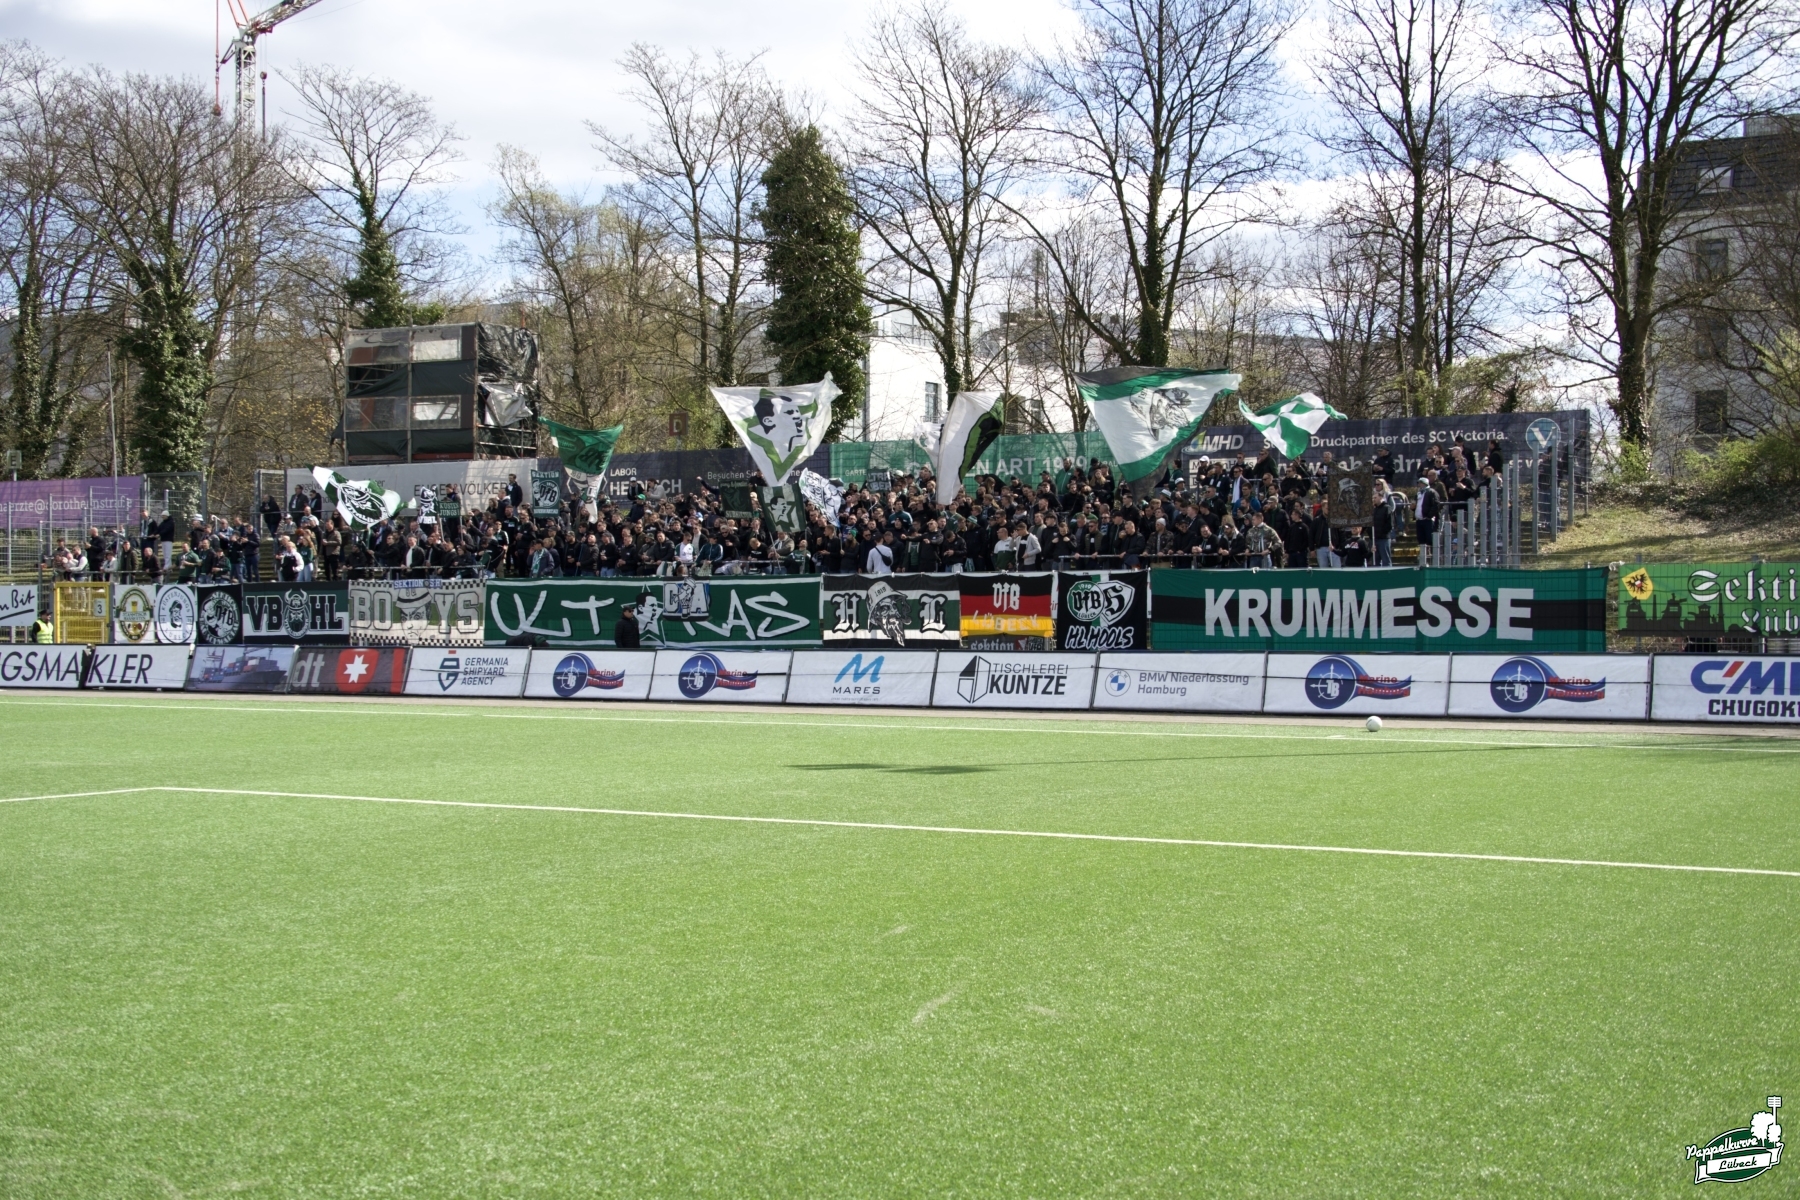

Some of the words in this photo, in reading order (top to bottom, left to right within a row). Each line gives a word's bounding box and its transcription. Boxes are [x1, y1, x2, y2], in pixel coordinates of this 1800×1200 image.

[673, 418, 682, 433] D
[1202, 434, 1244, 450] MHD
[1311, 432, 1397, 450] Druckpartner
[1401, 432, 1425, 444] des
[1428, 431, 1447, 443] SC
[1449, 428, 1508, 442] Victoria.
[11, 456, 17, 467] E
[995, 457, 1036, 476] ART
[609, 467, 637, 477] LABOR
[707, 471, 744, 480] Besuchen
[394, 579, 423, 588] SEKTION
[11, 588, 35, 609] Bit
[97, 603, 103, 615] 3
[1204, 585, 1534, 640] KRUMMESSE
[972, 610, 1039, 632] LÜBECK
[1064, 625, 1087, 649] HL
[1086, 626, 1134, 649] HOOLS
[0, 650, 153, 684] GSMAKLER
[464, 657, 509, 666] GERMANIA
[993, 662, 1069, 675] TISCHLEREI
[291, 652, 325, 688] dt
[462, 667, 505, 676] SHIPYARD
[460, 676, 496, 686] AGENCY
[989, 674, 1068, 696] KUNTZE
[1139, 672, 1167, 683] BMW
[1170, 671, 1250, 686] Niederlassung
[1358, 674, 1397, 683] Marine
[1548, 676, 1591, 686] Marine
[832, 686, 880, 695] MARES
[1137, 684, 1187, 696] Hamburg
[1708, 698, 1800, 718] CHUGOK
